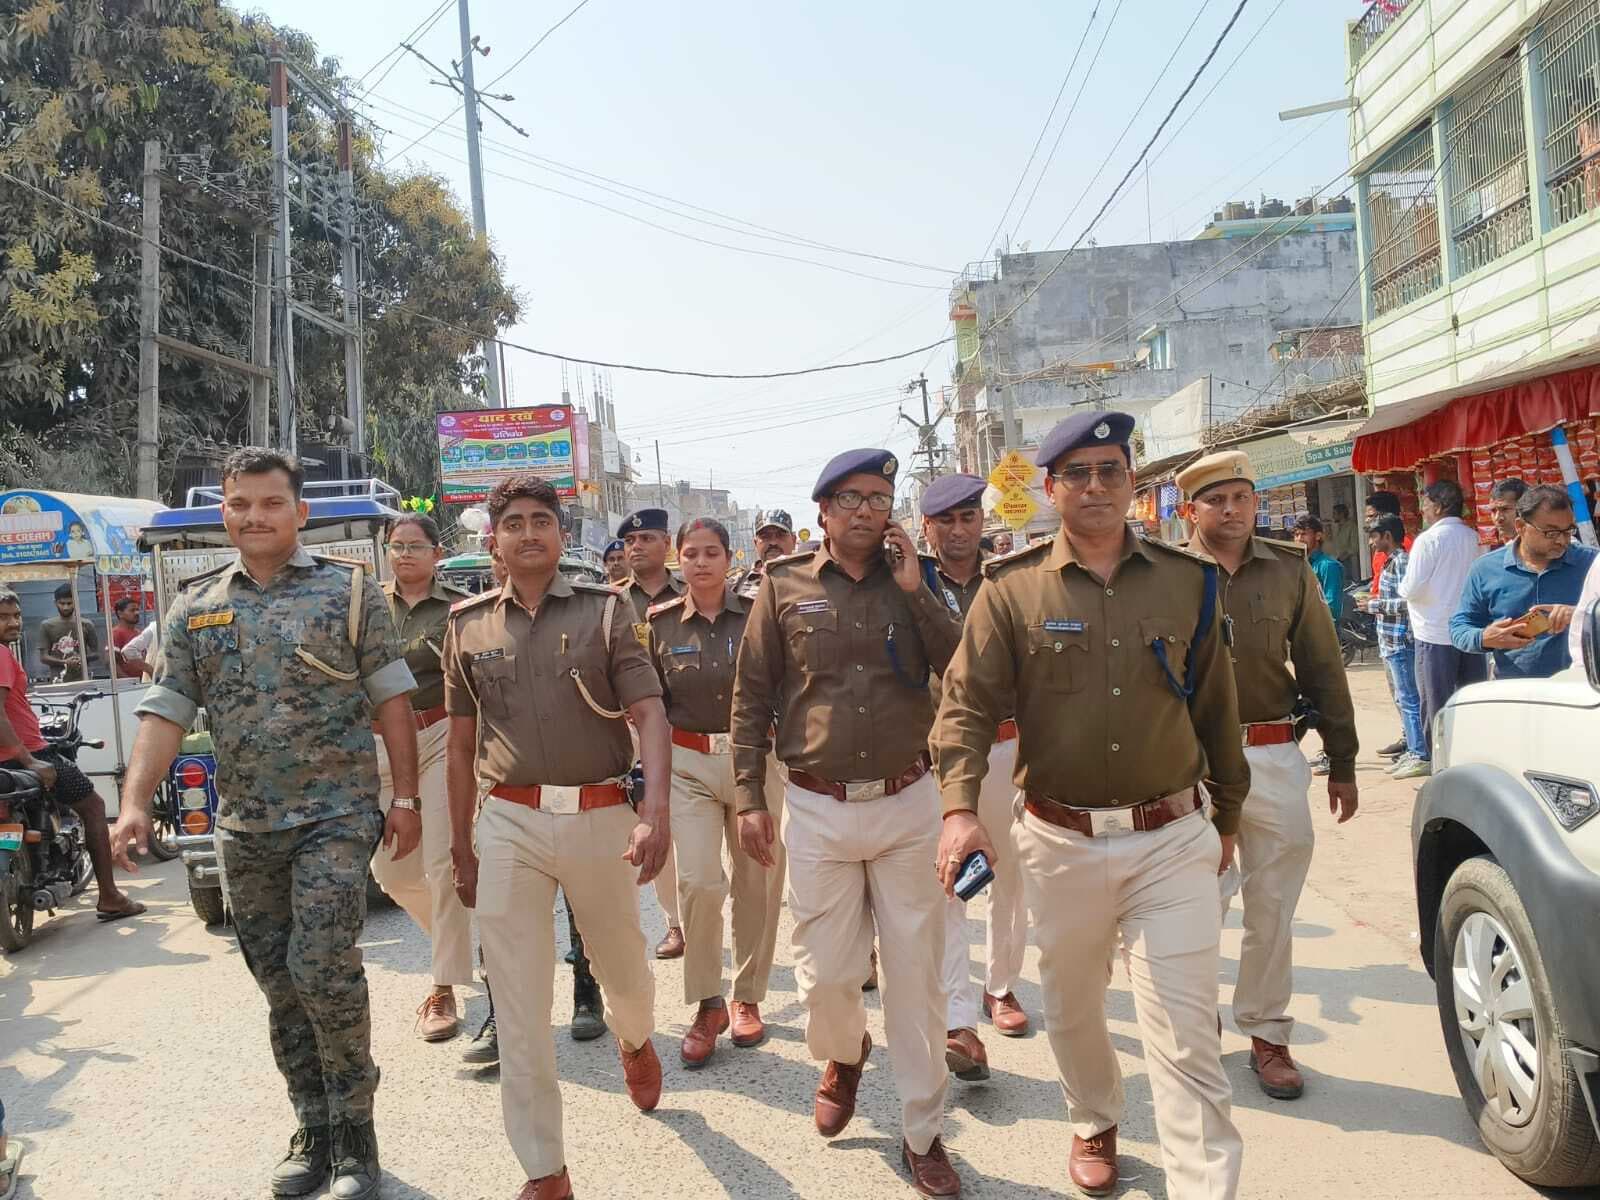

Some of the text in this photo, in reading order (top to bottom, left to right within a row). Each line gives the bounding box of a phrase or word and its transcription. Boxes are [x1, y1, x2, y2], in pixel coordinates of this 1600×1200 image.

[1306, 446, 1352, 462] Spa & Salo
